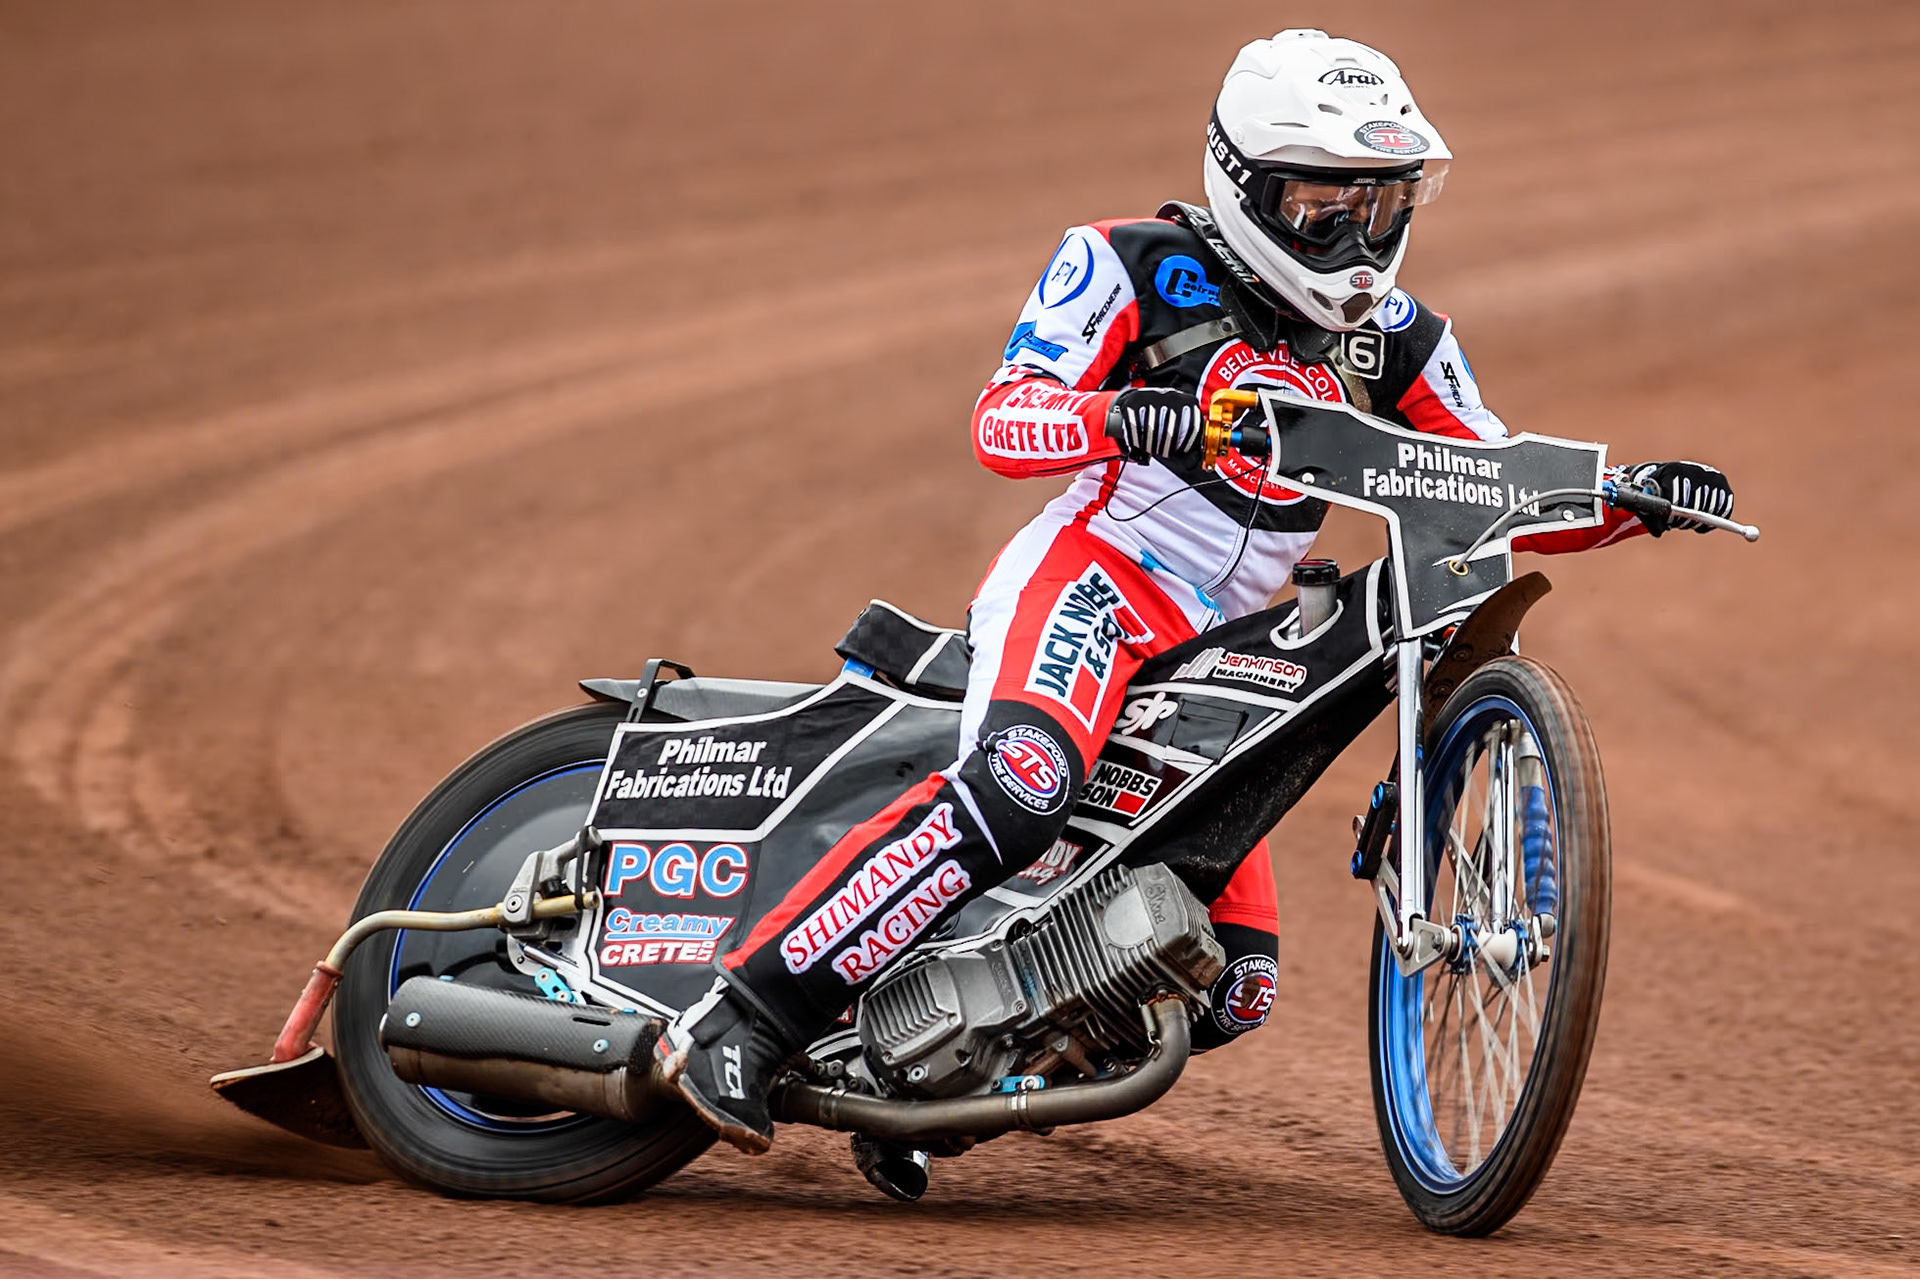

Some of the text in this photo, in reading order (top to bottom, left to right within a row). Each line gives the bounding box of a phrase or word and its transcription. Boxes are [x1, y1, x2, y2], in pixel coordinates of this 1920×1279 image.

[1326, 70, 1379, 86] Arai
[1368, 132, 1414, 145] STS
[1351, 274, 1373, 286] STS
[1348, 335, 1376, 371] 6
[1218, 348, 1335, 403] BELLE VUE COL
[983, 415, 1083, 453] CRETE LTD
[1397, 442, 1503, 480] Philmar
[1362, 468, 1504, 508] Fabrications
[1035, 622, 1088, 698] JACK
[1085, 646, 1108, 680] &
[1215, 668, 1298, 690] MACHINERY
[657, 735, 768, 765] Philmar
[1000, 740, 1059, 790] STS
[1007, 728, 1067, 778] STAKEFORD
[604, 765, 793, 800] Fabrications Ltd
[1000, 775, 1050, 810] SERVICES
[1079, 782, 1119, 808] SON
[1092, 762, 1159, 797] NOBBS
[604, 841, 750, 898] PGC
[786, 807, 956, 968] SHIMANDY
[606, 907, 735, 938] Creamy
[839, 866, 966, 982] RACING
[1233, 958, 1278, 982] STAKEFOR
[1216, 1007, 1233, 1029] TYRE
